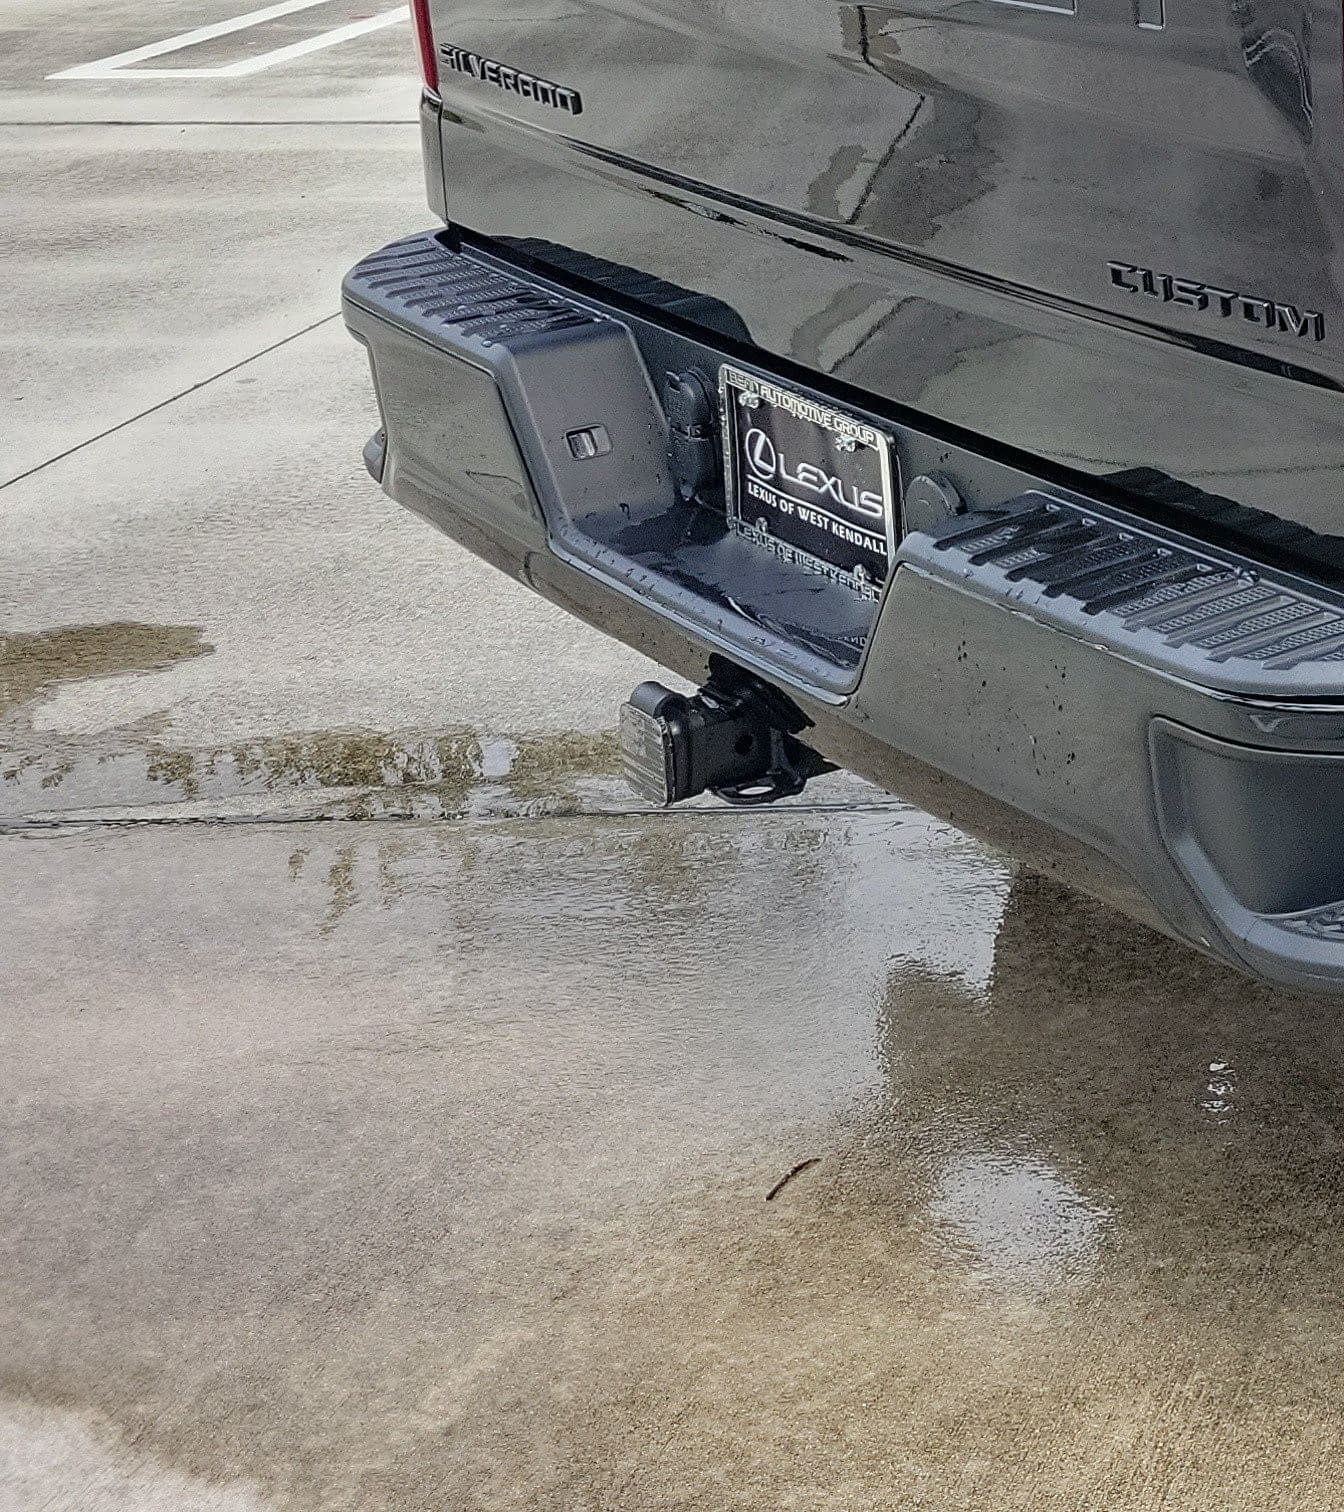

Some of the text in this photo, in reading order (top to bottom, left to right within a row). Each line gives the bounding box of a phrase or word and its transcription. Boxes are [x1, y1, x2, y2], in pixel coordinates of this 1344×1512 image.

[439, 42, 583, 115] SILVERADO
[1106, 260, 1327, 342] CUSTOM
[760, 383, 832, 426] AUTOMOTIVE
[833, 417, 875, 443] GROUP
[747, 481, 888, 557] LEXUS OF WEST KENDALL
[778, 453, 884, 518] LEXUS
[736, 522, 776, 553] LEXUS
